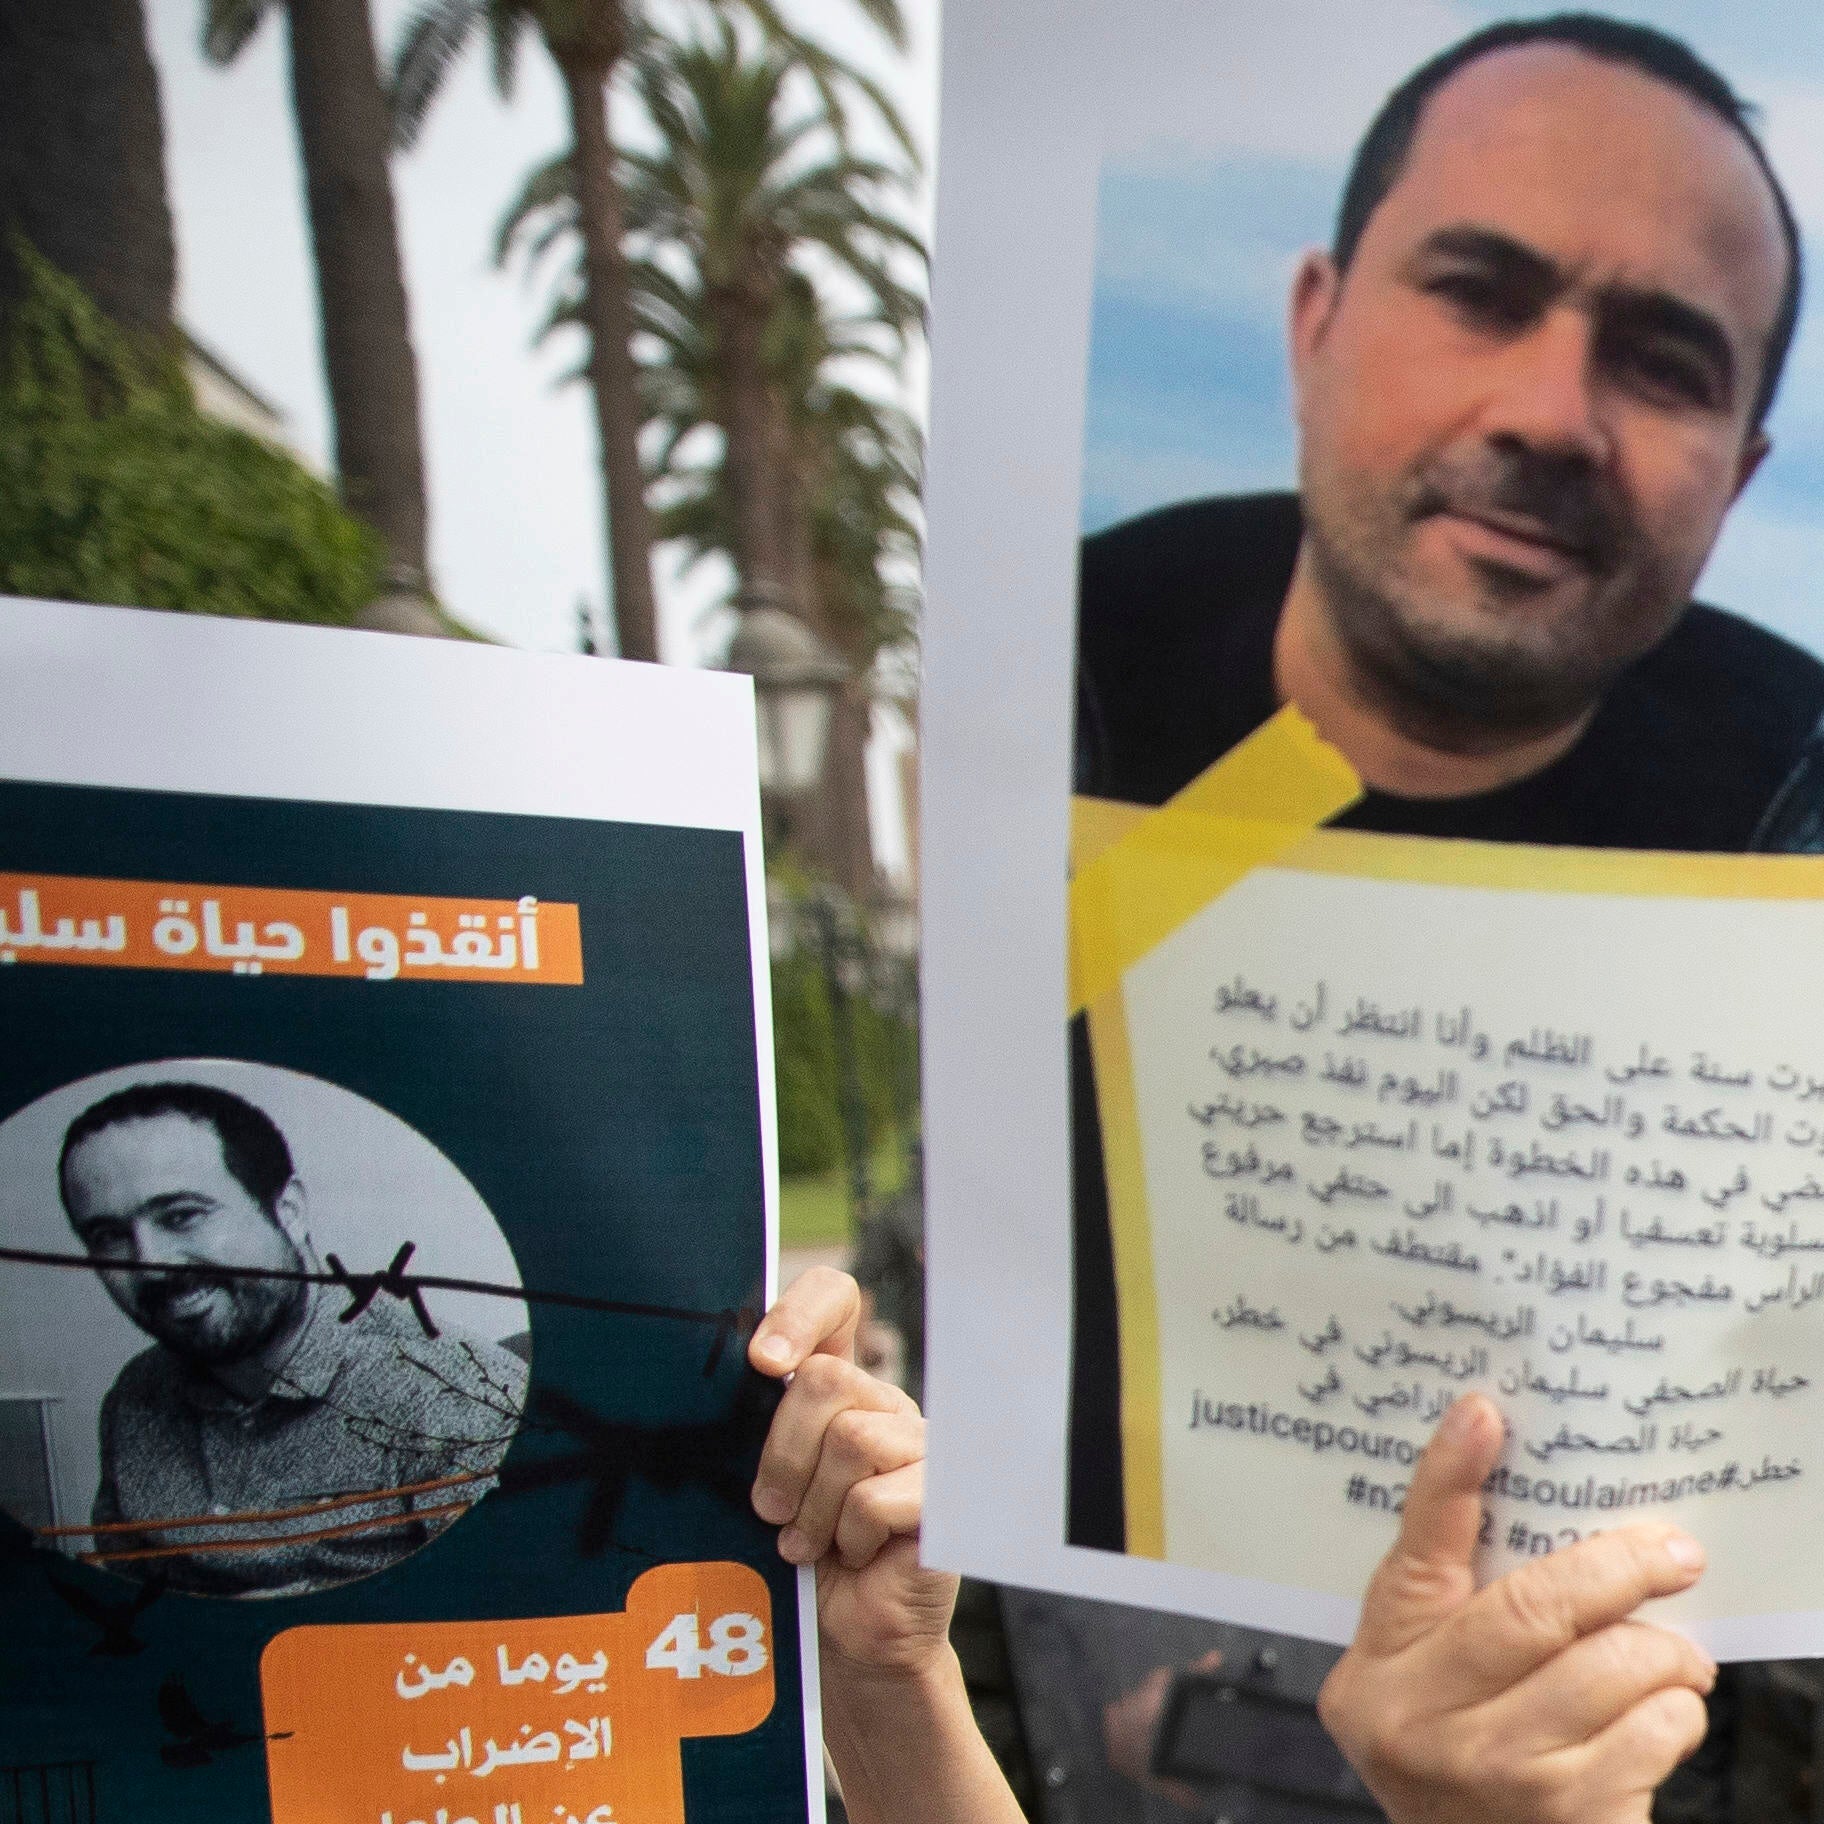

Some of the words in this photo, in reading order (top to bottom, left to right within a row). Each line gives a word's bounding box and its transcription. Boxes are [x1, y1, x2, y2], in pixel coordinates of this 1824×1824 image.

[152, 899, 306, 975] حياة
[330, 895, 540, 980] أنقذوا
[1505, 1027, 1593, 1068] الظلم
[1605, 1043, 1671, 1084] على
[1470, 1080, 1529, 1121] لكن
[1662, 1104, 1774, 1143] الحكمة
[1701, 1164, 1751, 1210] في
[1315, 1224, 1358, 1253] من
[1299, 1314, 1343, 1353] في
[1549, 1312, 1664, 1355] سليمان
[1298, 1364, 1343, 1405] في
[1751, 1366, 1809, 1399] حياة
[1669, 1420, 1723, 1451] حياة
[645, 1611, 770, 1679] 48
[395, 1652, 475, 1699] من
[496, 1644, 610, 1694] يوما
[401, 1716, 612, 1785] الإضراب
